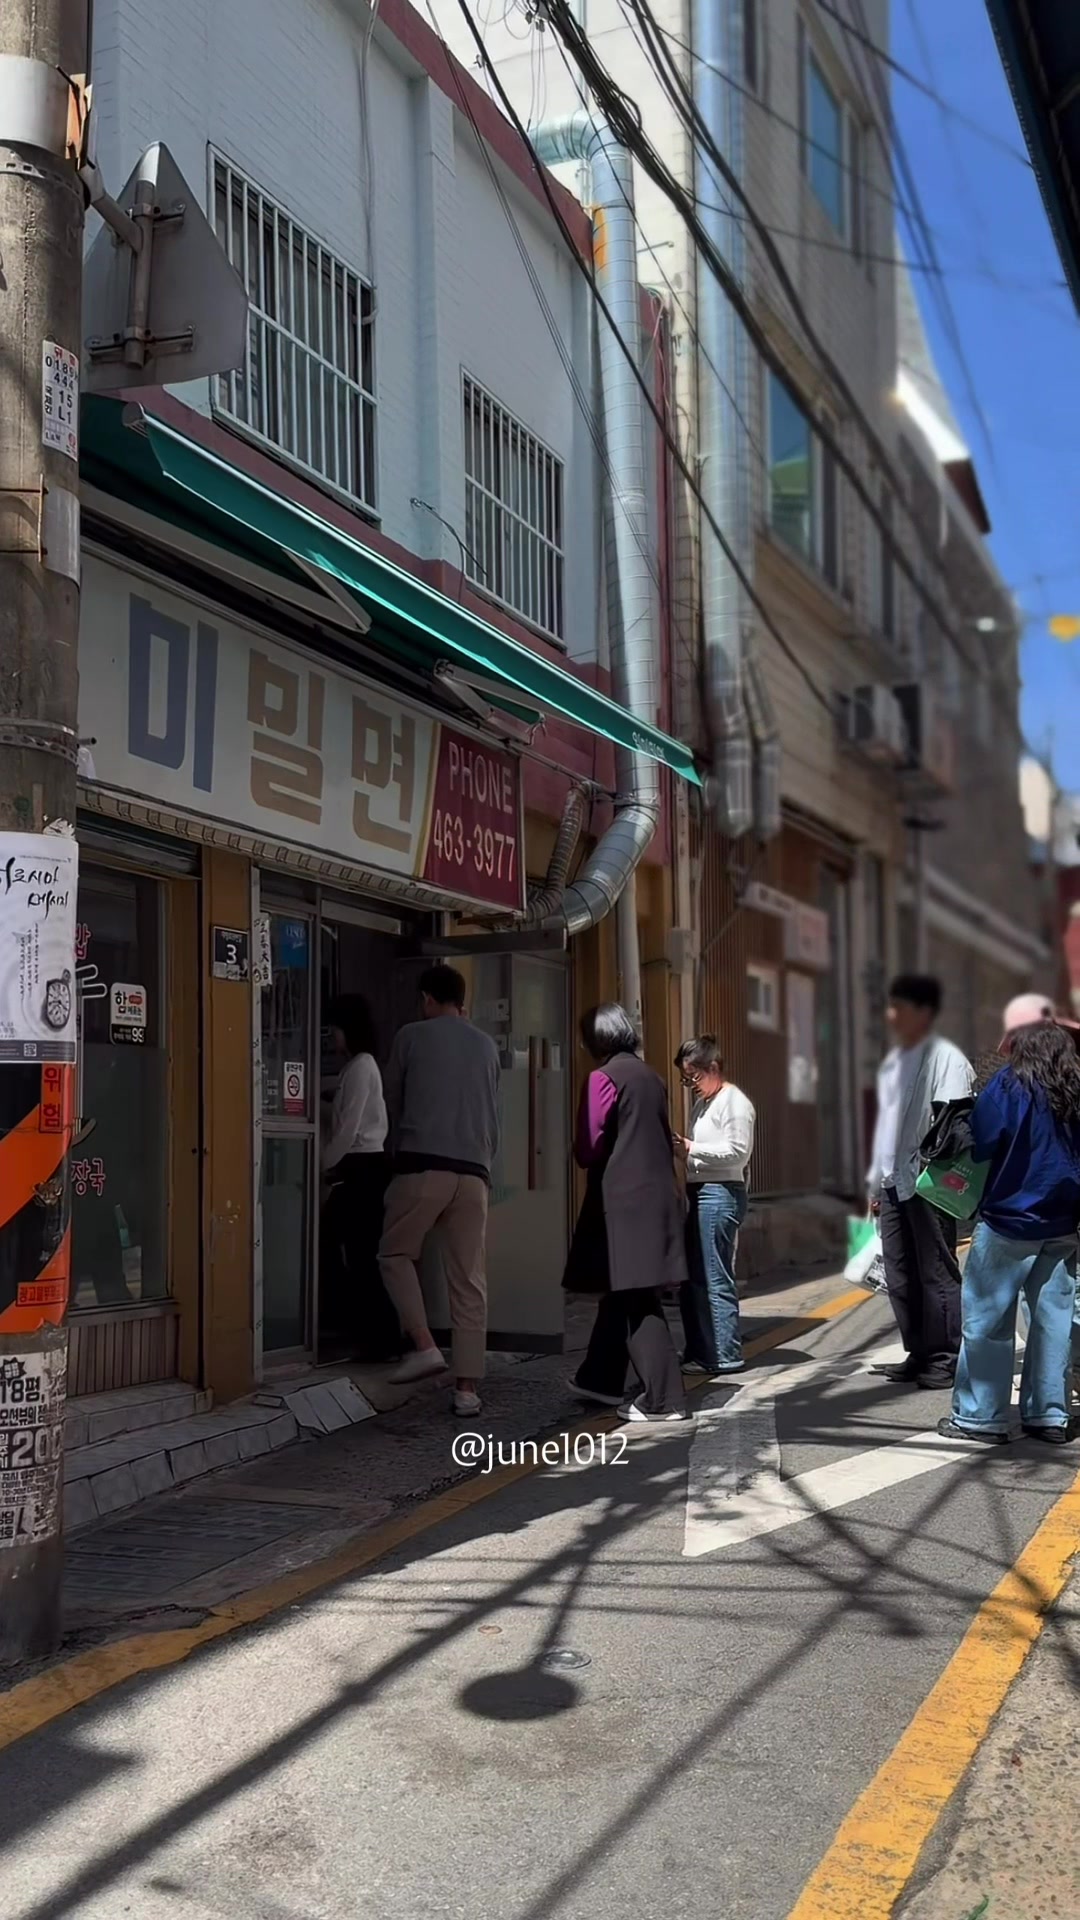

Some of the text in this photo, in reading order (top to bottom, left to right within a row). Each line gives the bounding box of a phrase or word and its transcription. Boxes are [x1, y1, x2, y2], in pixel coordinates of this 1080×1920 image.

[59, 390, 73, 409] 15
[447, 740, 514, 815] PHONE
[433, 808, 516, 883] 463-3977
[226, 943, 238, 965] 3
[132, 1027, 145, 1043] 99
[43, 1067, 61, 1127] 위험
[71, 1157, 107, 1196] 장국
